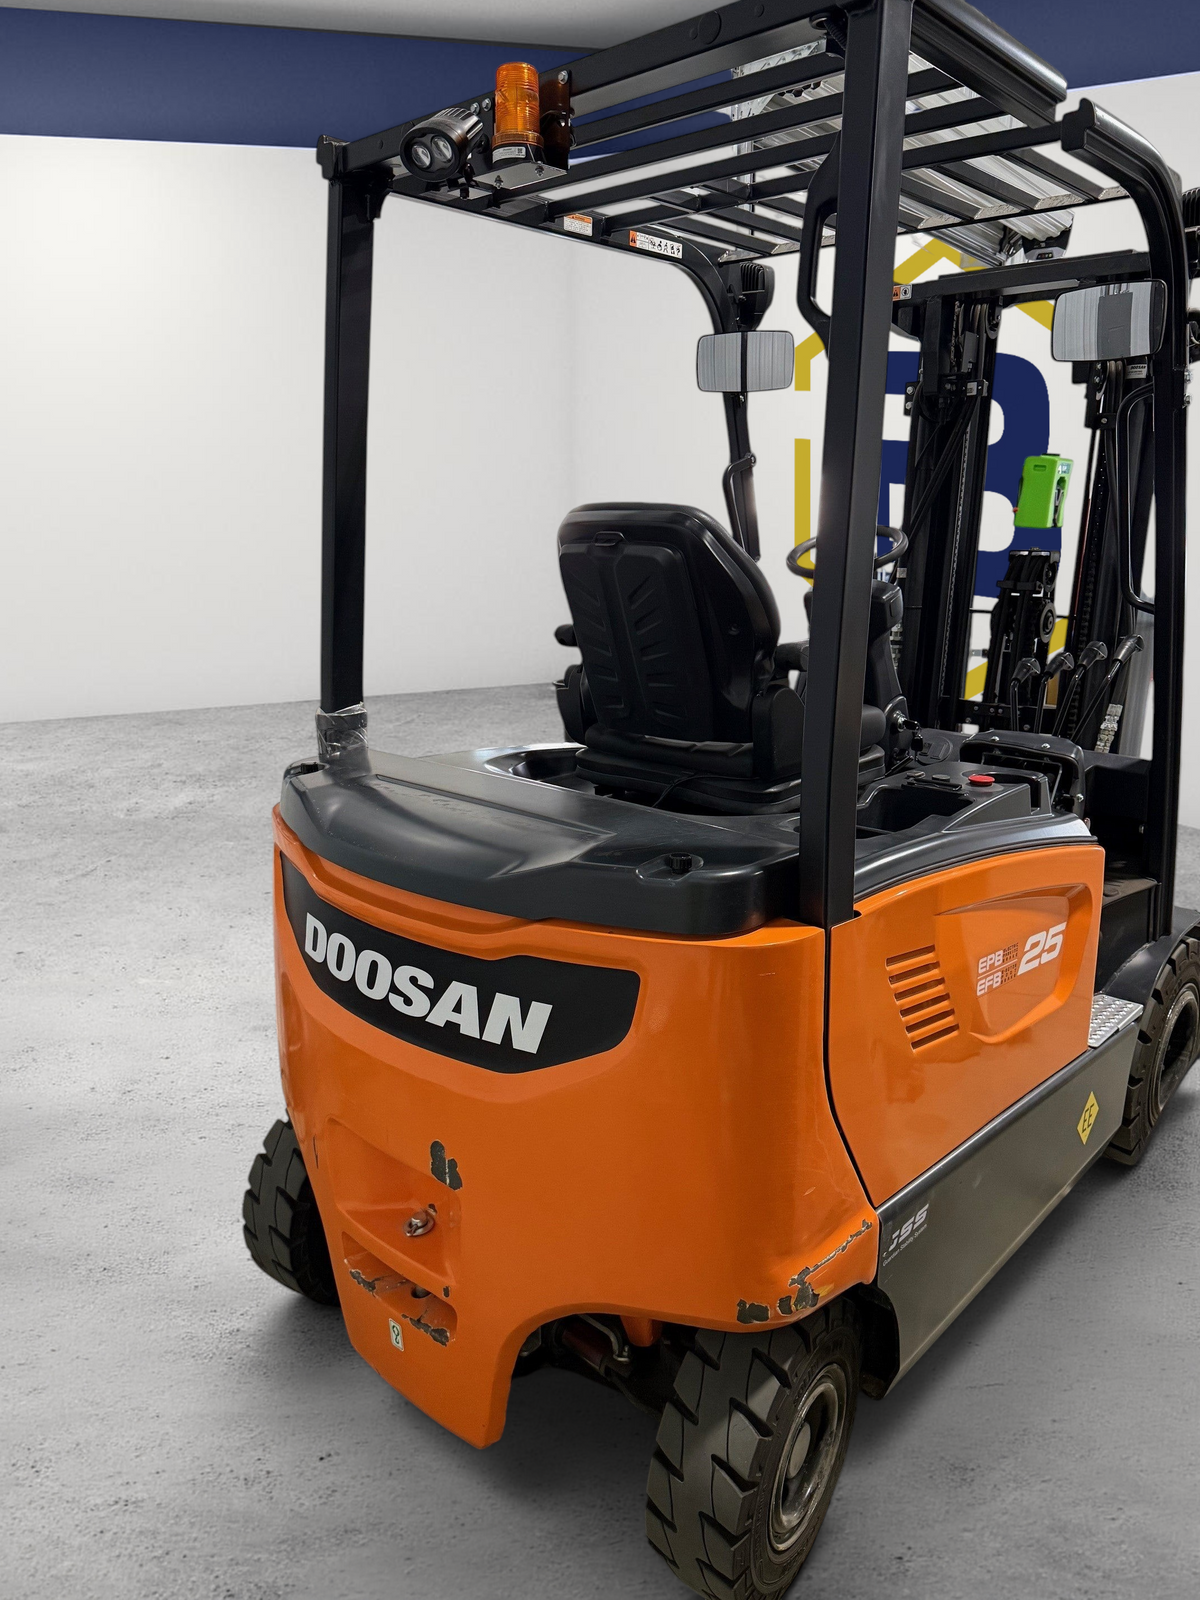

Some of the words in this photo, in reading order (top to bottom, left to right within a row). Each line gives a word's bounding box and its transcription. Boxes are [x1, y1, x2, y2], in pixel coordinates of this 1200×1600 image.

[978, 949, 1003, 974] EPB
[1017, 921, 1067, 976] 25
[304, 912, 553, 1055] DOOSAN
[976, 971, 1002, 996] EFB
[1082, 1103, 1095, 1134] EE
